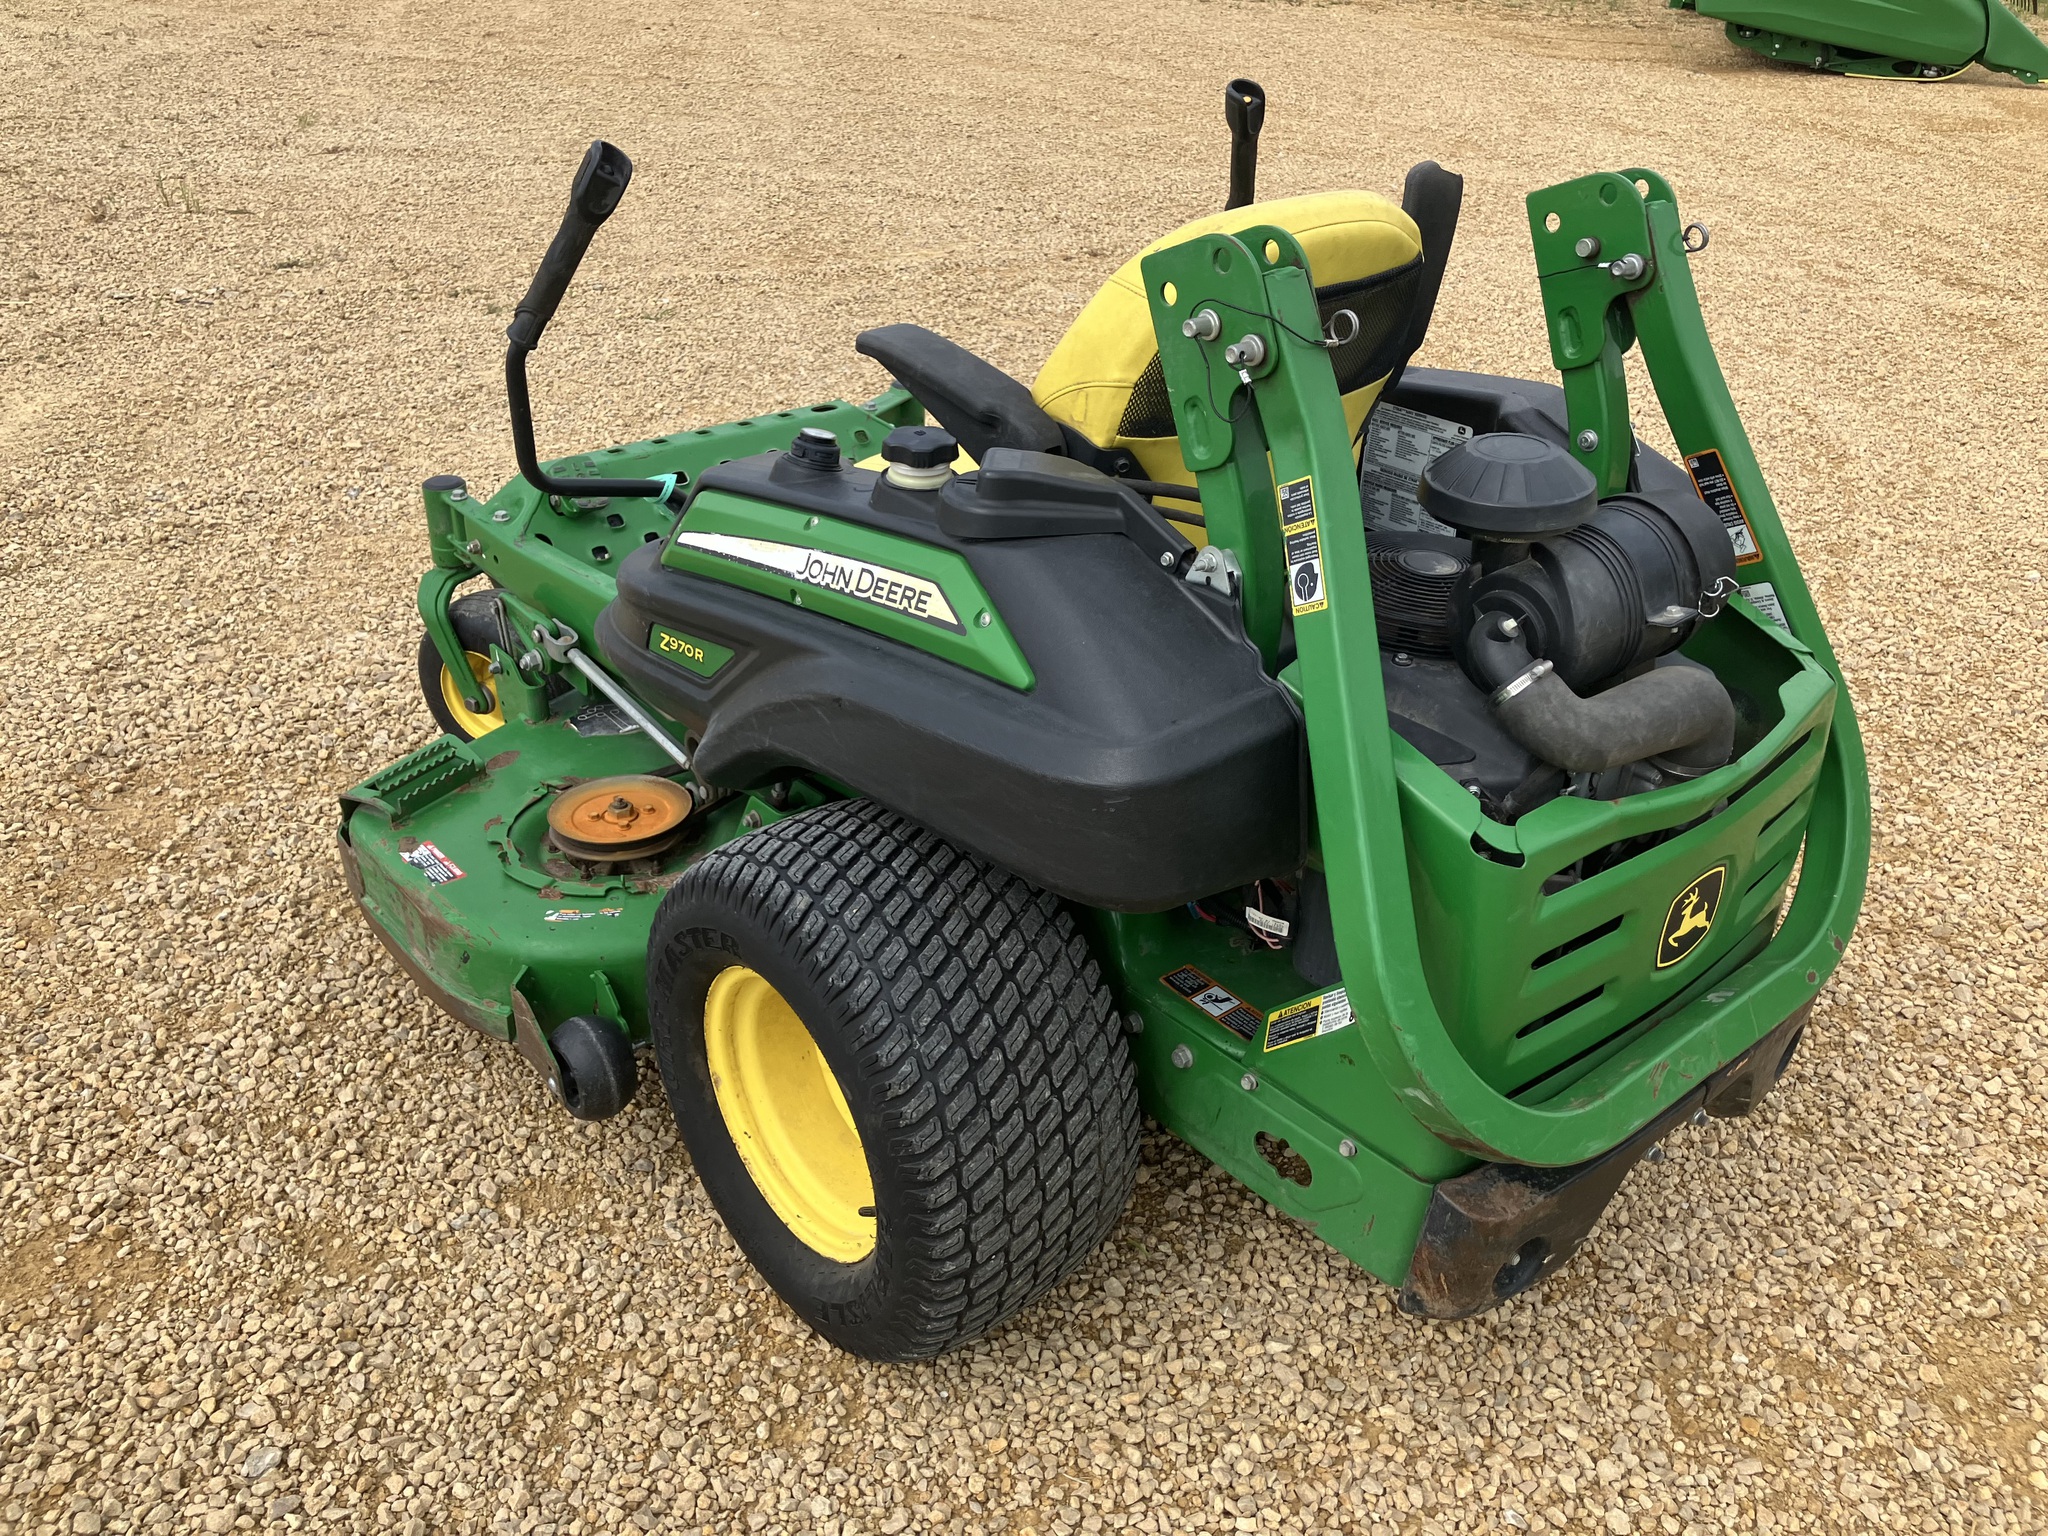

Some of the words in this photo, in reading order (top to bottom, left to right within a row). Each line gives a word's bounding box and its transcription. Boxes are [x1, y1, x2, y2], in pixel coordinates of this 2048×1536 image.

[797, 553, 854, 590] JOHN
[856, 568, 932, 614] DEERE
[1296, 603, 1319, 614] CAUTION
[659, 632, 704, 663] Z970R
[656, 927, 742, 1002] MASTER
